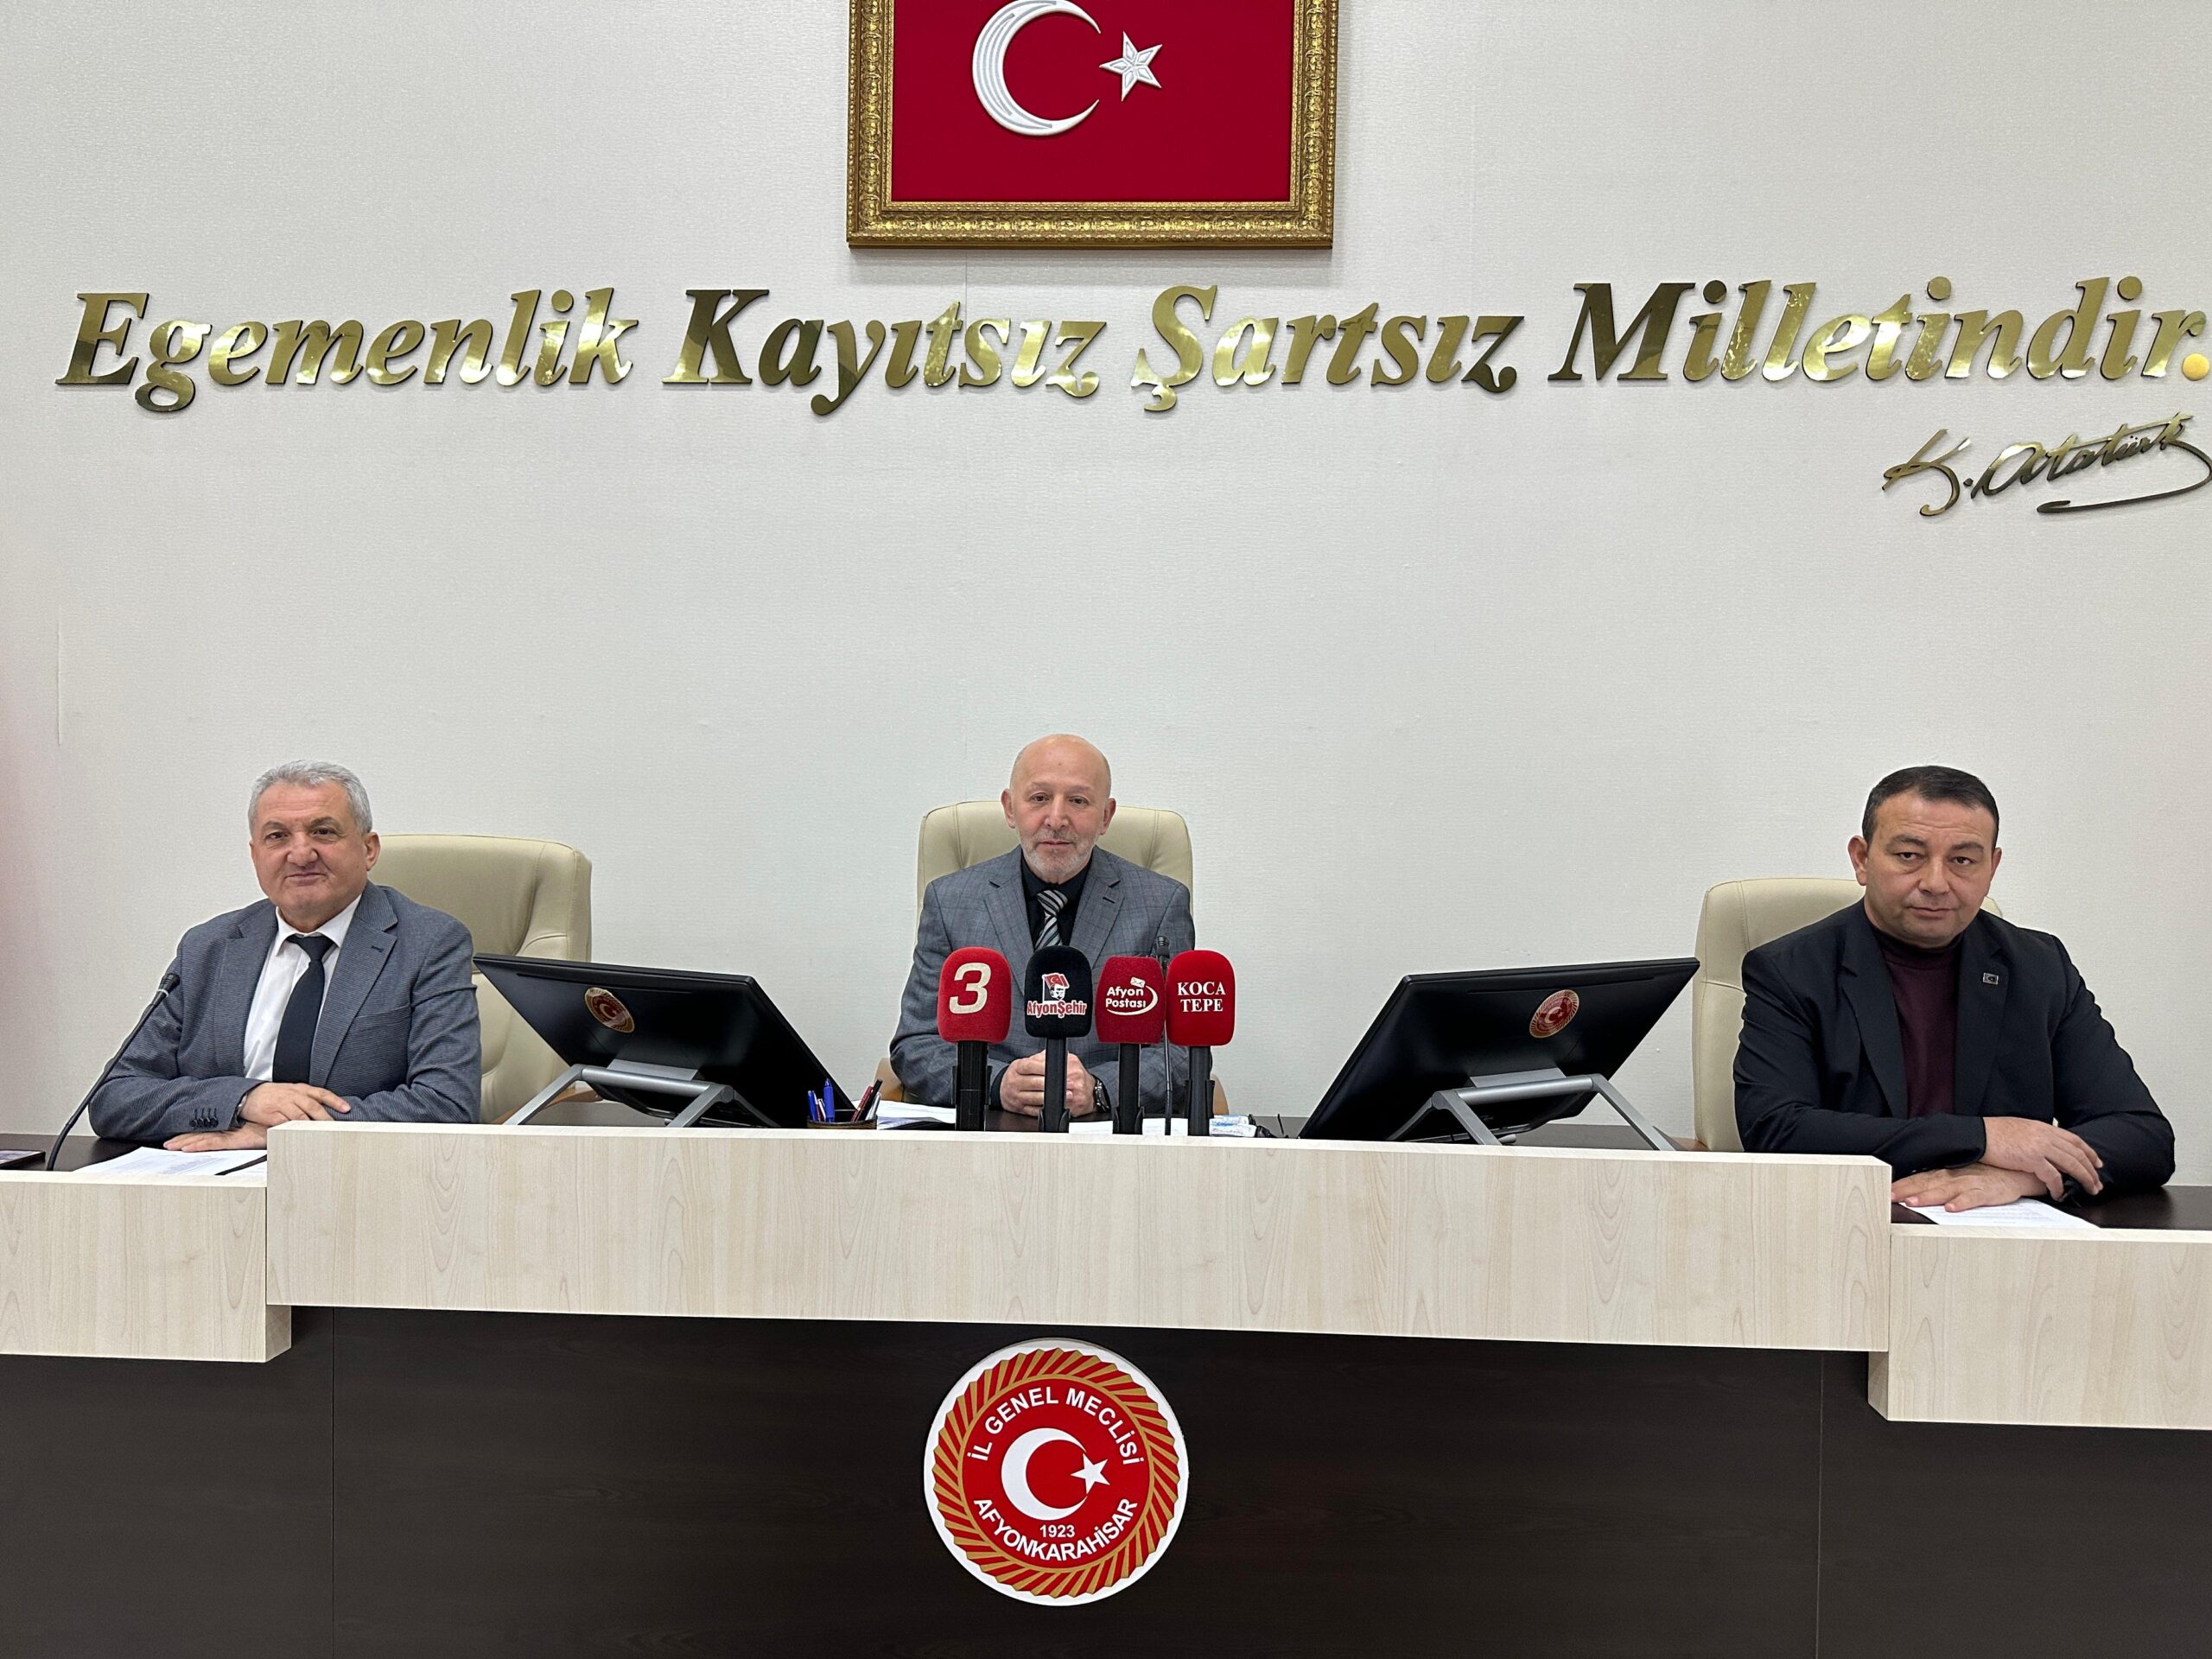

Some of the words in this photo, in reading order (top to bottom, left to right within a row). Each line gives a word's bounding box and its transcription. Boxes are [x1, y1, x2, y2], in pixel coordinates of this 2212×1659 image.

[55, 288, 639, 412] Egemenlik
[662, 288, 1107, 416] Kayıtsız
[1131, 285, 1524, 412] Şartsız
[1548, 276, 2210, 381] Milletindir.
[949, 962, 992, 1014] 3
[1106, 986, 1145, 999] Afyon
[1177, 981, 1226, 996] KOCA
[1027, 1001, 1087, 1019] AfyonŞehir
[1105, 997, 1147, 1009] Postası
[1180, 998, 1224, 1013] TEPE
[967, 1441, 992, 1461] İL
[985, 1387, 1058, 1434] GENEL
[1065, 1387, 1145, 1465] MECLİSİ
[973, 1497, 1138, 1561] AFYONKARAHİSAR
[1039, 1524, 1075, 1538] 1923
